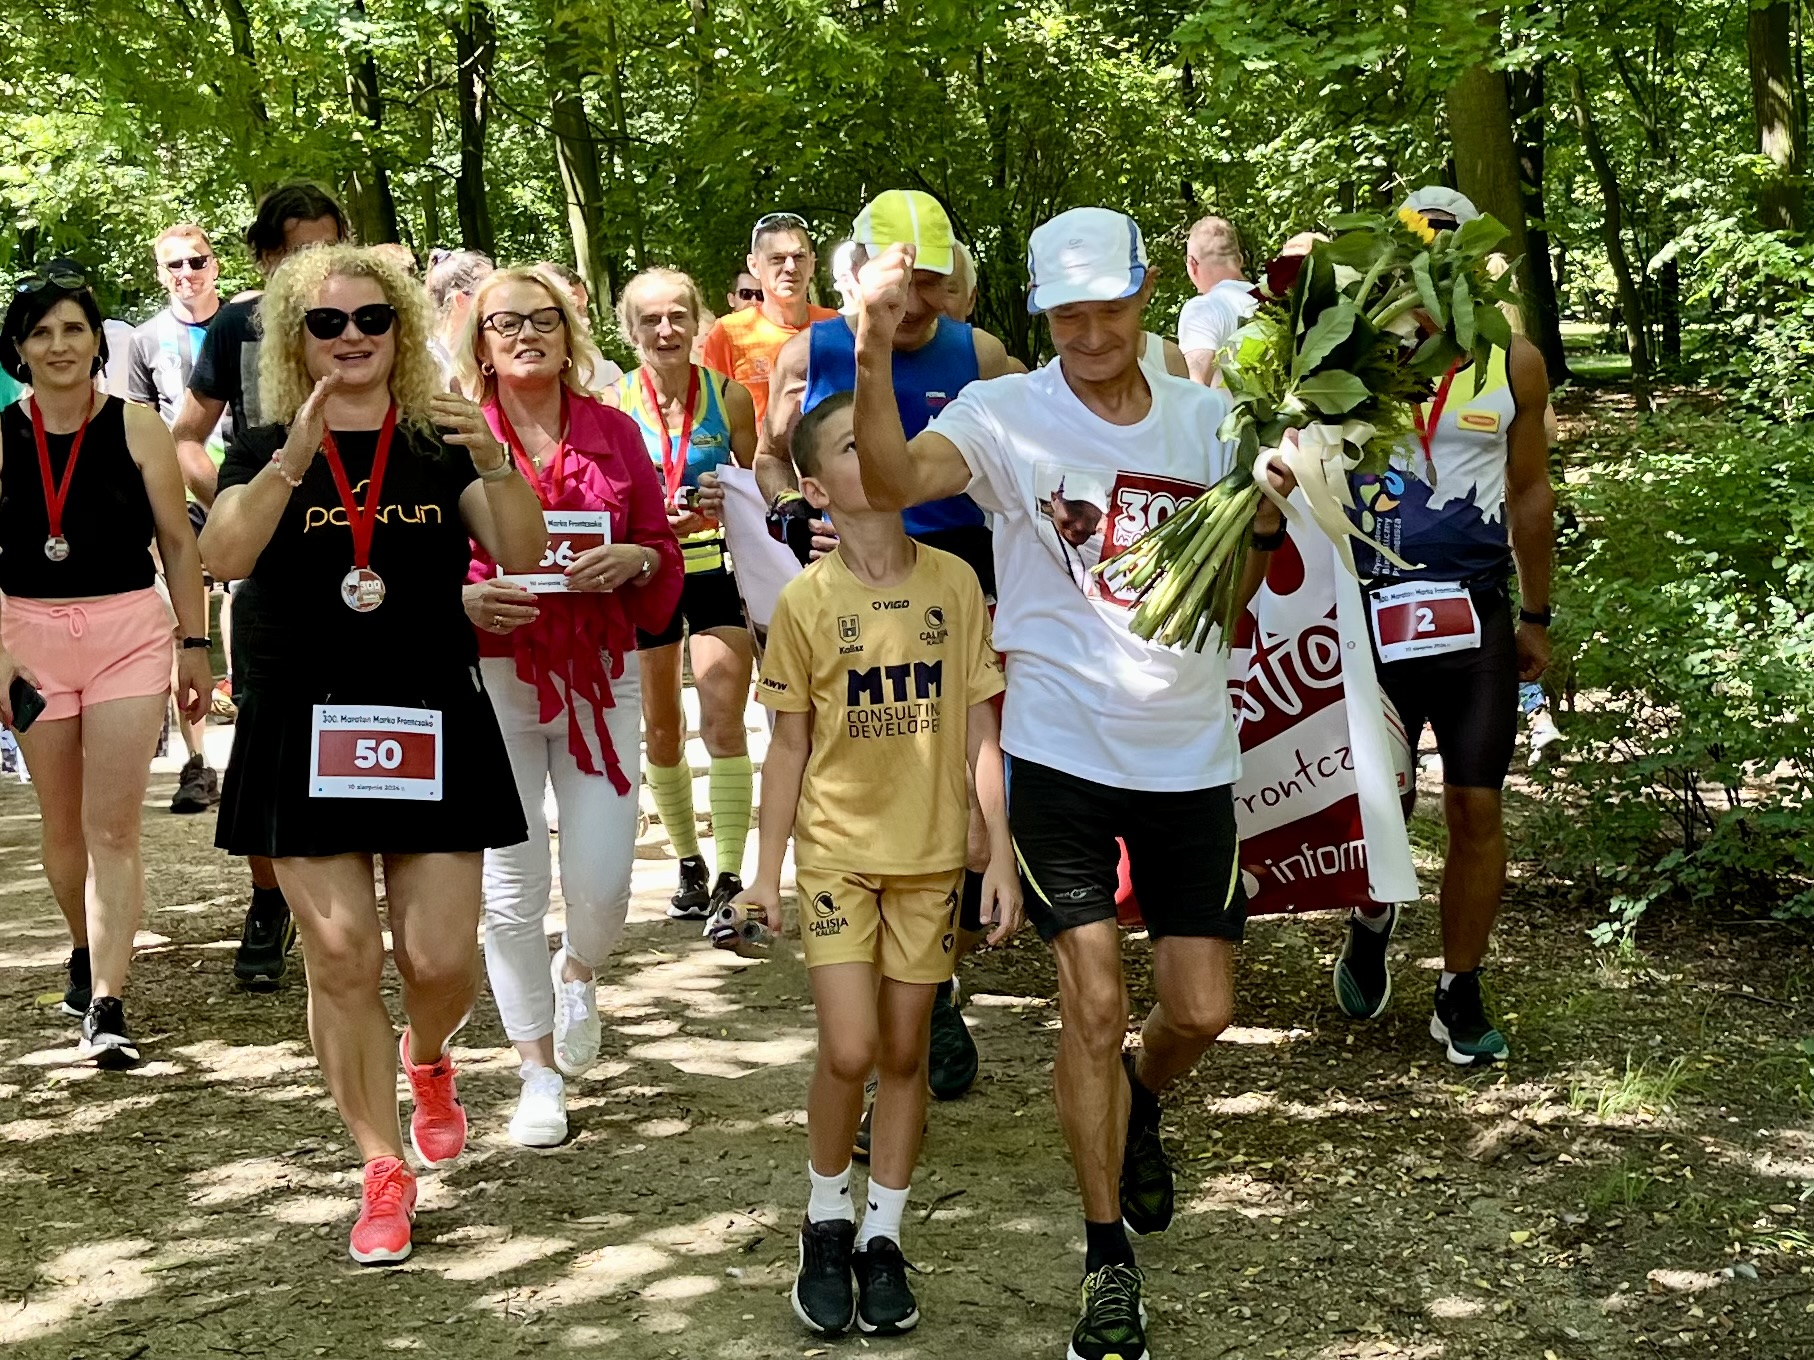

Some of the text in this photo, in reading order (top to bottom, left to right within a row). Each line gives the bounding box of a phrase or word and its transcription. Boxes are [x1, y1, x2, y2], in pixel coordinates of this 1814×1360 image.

[1415, 607, 1436, 632] 2
[847, 659, 943, 706] MTM
[354, 738, 403, 769] 50
[808, 917, 849, 932] CALISIA
